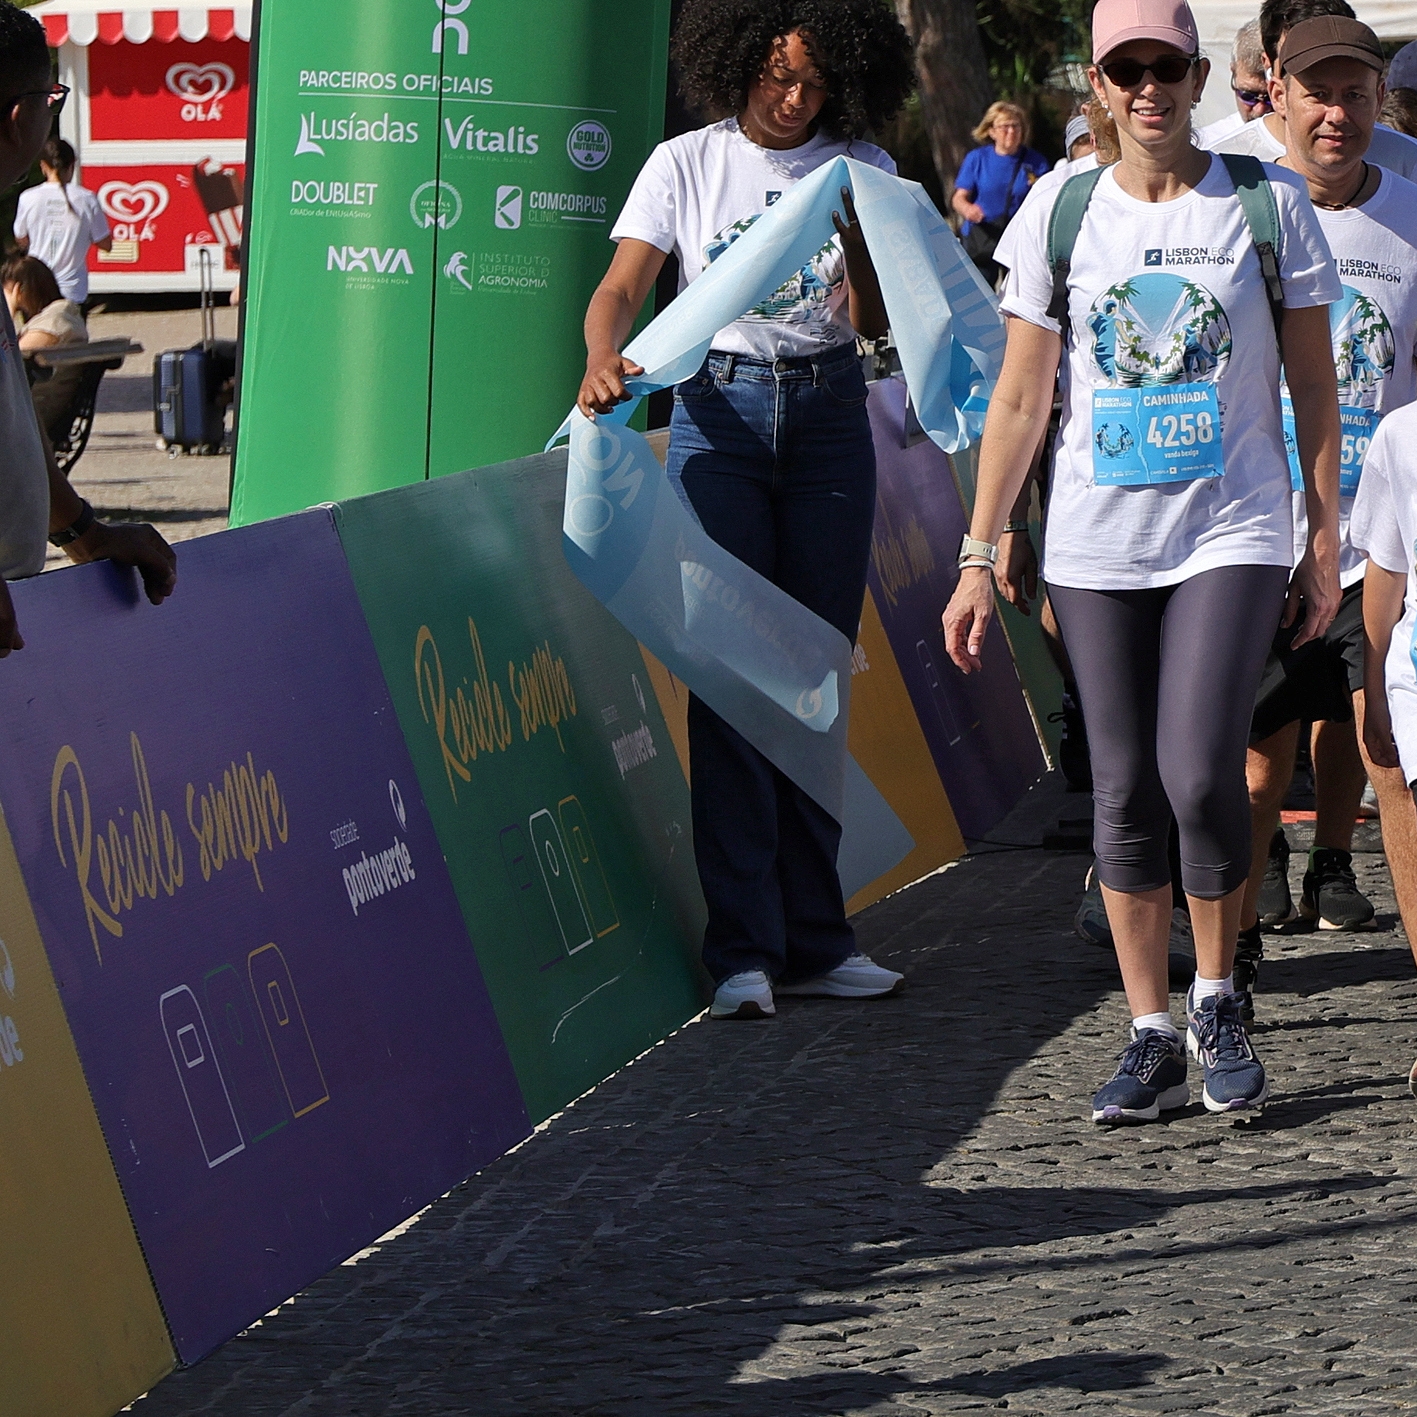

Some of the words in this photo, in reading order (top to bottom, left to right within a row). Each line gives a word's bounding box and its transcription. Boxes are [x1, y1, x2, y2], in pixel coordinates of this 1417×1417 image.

[299, 71, 396, 89] PARCEIROS
[403, 74, 493, 94] OFICIAIS
[181, 92, 223, 121] OLÁ
[310, 111, 418, 143] Lusíadas
[444, 115, 539, 155] Vitalis
[576, 130, 604, 142] GOLD
[292, 181, 378, 205] DOUBLET
[530, 191, 607, 214] COMCORPUS
[528, 210, 558, 223] CLINIC
[113, 217, 156, 242] OLÁ
[480, 253, 550, 266] INSTITUTO
[1165, 248, 1208, 259] LISBON
[1165, 256, 1235, 266] MARATHON
[479, 264, 536, 277] SUPERIOR
[1340, 259, 1379, 271] LISBON
[479, 275, 547, 288] AGRONOMIA
[1339, 267, 1401, 283] MARATHON
[1143, 391, 1209, 406] CAMINHADA
[1147, 412, 1213, 448] 4258
[51, 730, 186, 966] Recicle
[186, 750, 289, 893] sempre
[342, 836, 416, 916] pontoverde
